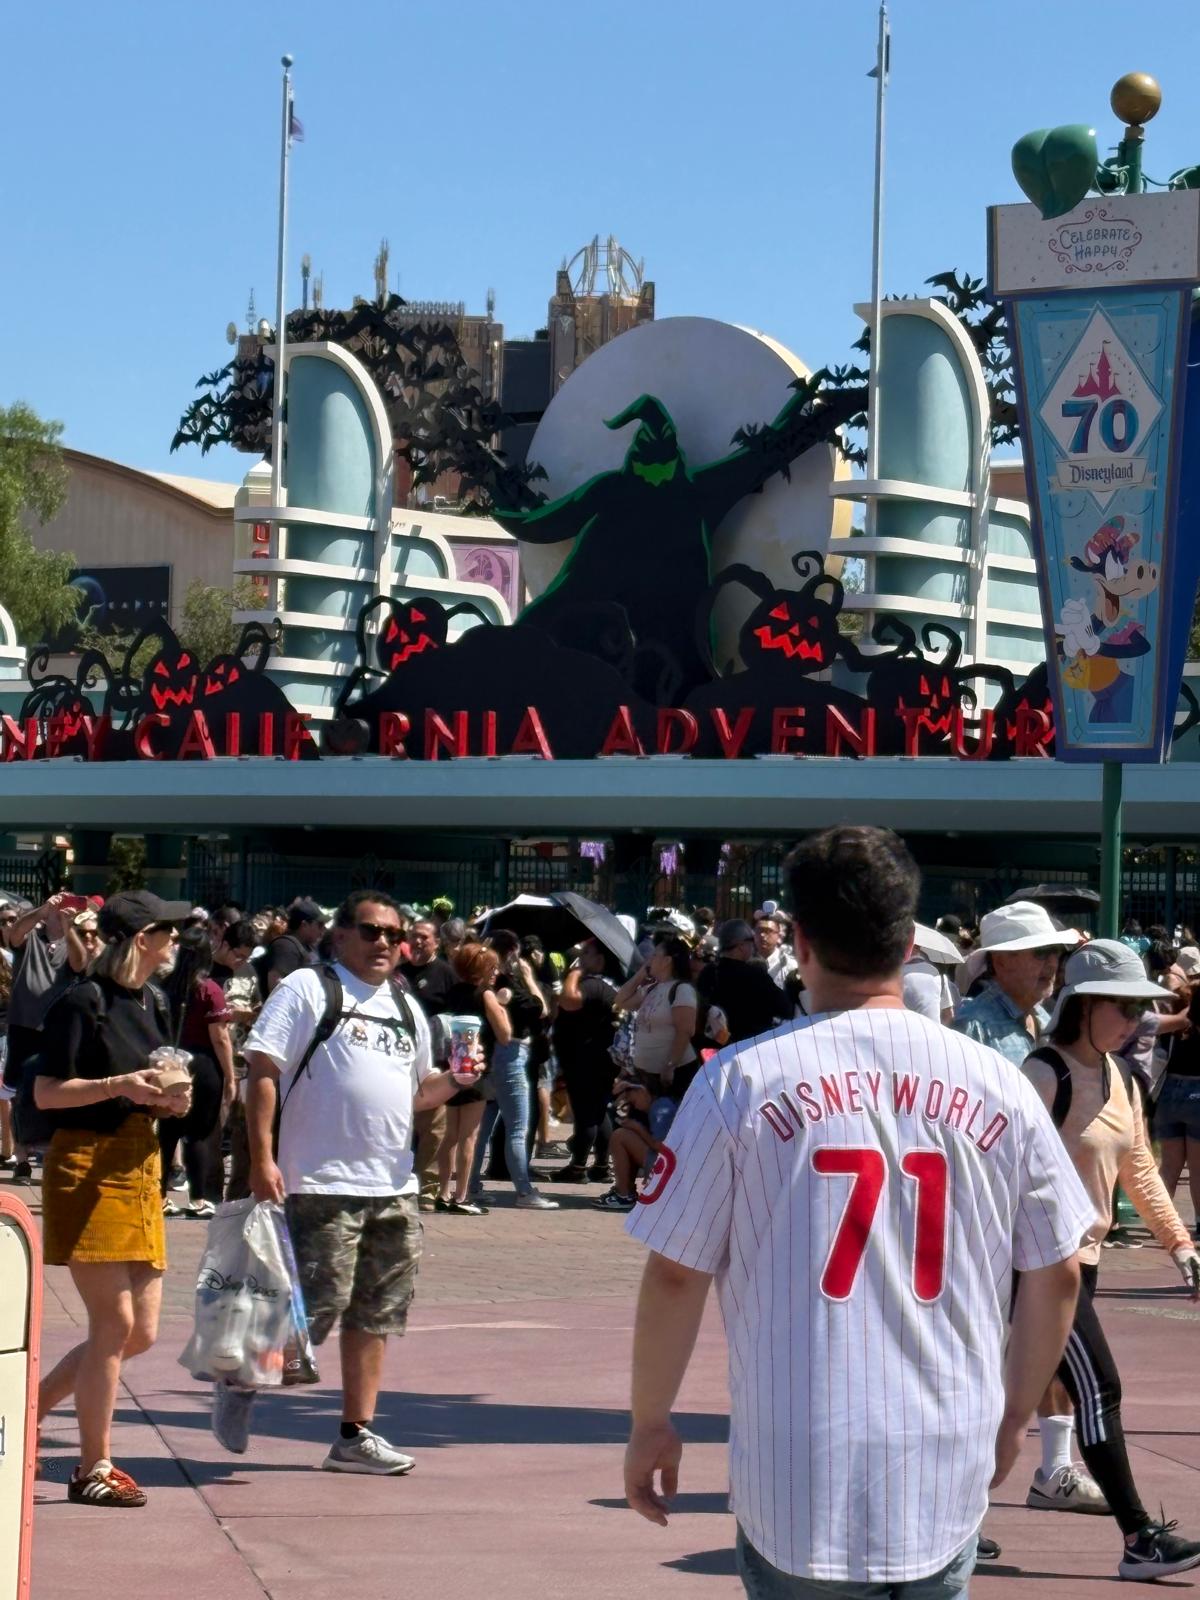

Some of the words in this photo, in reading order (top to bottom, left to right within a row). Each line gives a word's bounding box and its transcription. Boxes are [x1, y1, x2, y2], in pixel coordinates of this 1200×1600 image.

[1061, 228, 1131, 249] CELEBRATE
[1074, 245, 1118, 260] HAPPY
[1061, 399, 1139, 454] 70
[1070, 464, 1133, 484] Disneyland
[812, 1148, 950, 1303] 71
